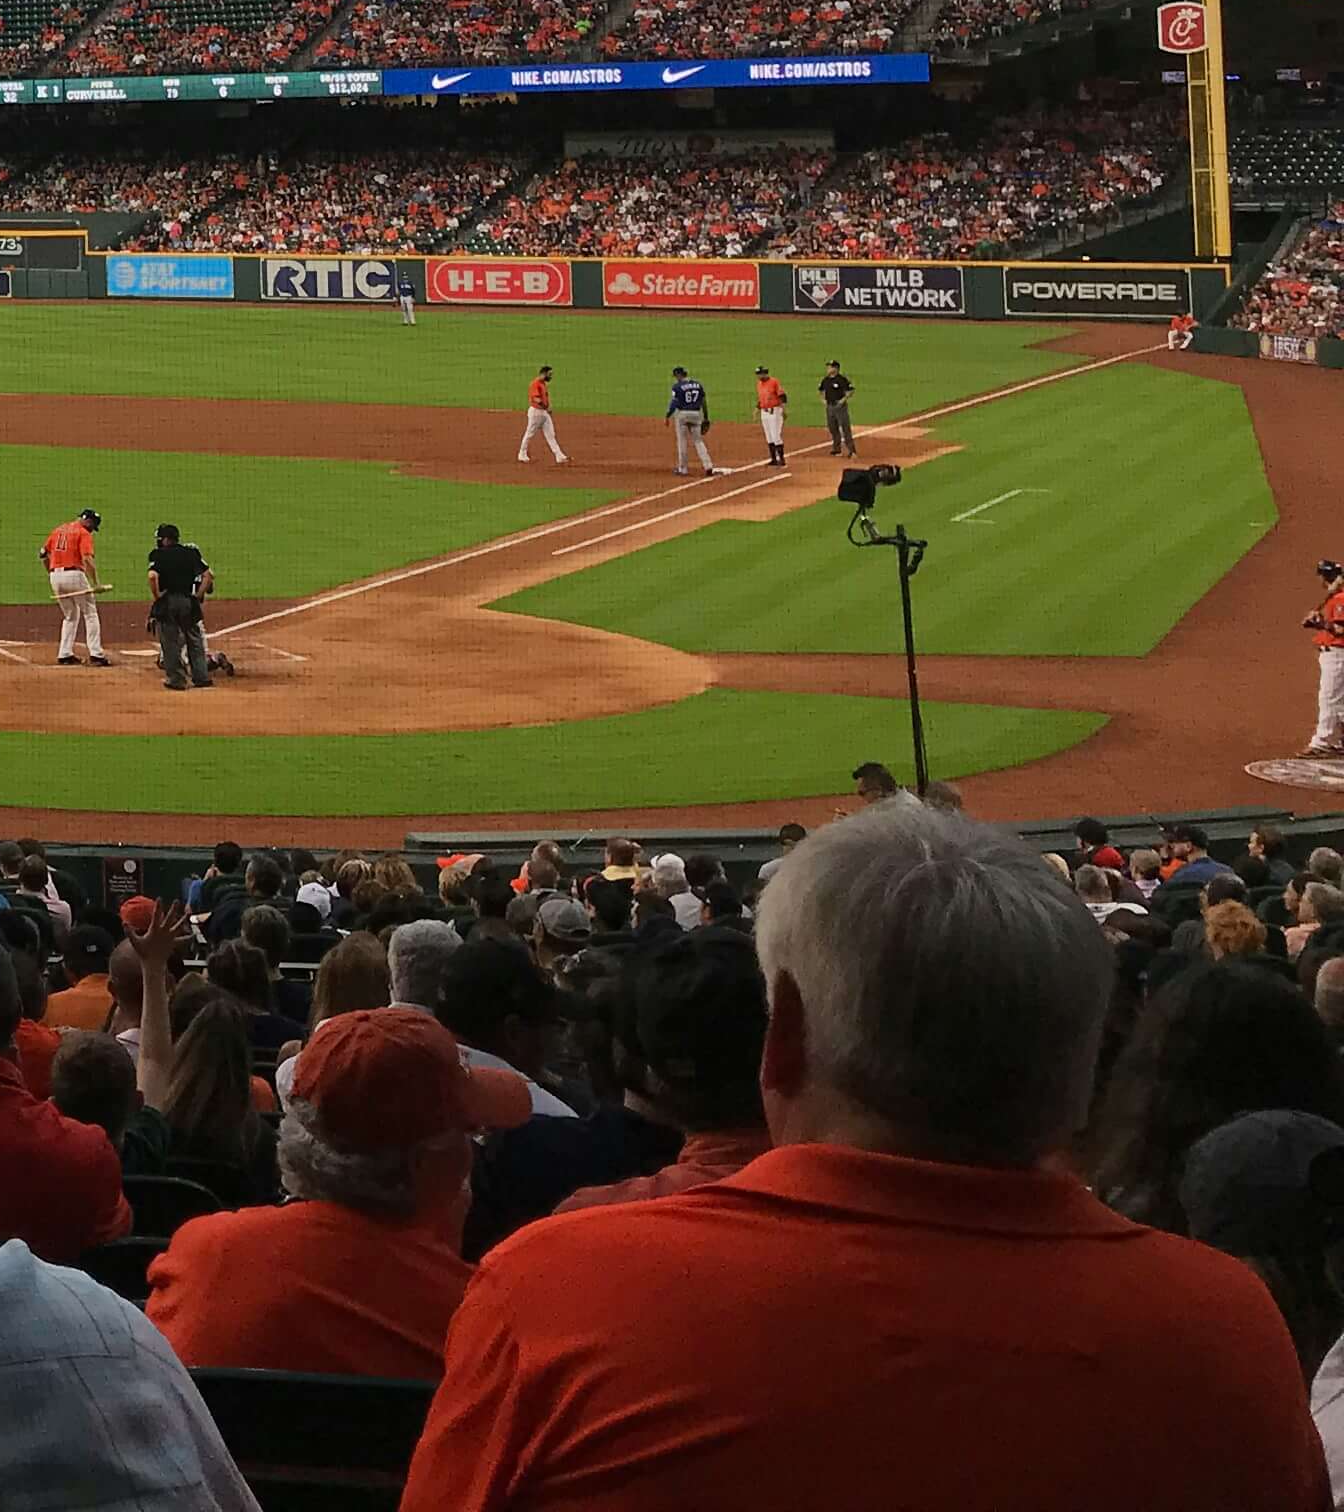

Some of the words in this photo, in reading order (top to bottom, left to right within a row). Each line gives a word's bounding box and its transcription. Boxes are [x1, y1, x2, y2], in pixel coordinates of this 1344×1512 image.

[511, 69, 622, 87] NIKE.COM/ASTROS
[750, 61, 871, 80] NIKE.COM/ASTROS
[265, 260, 392, 299] RTIC
[448, 270, 550, 294] H-E-B
[641, 272, 697, 296] State
[699, 277, 755, 297] Farm
[800, 268, 838, 283] MLB
[874, 268, 925, 287] MLB
[844, 287, 958, 308] NETWORK
[1012, 281, 1178, 301] POWERADE
